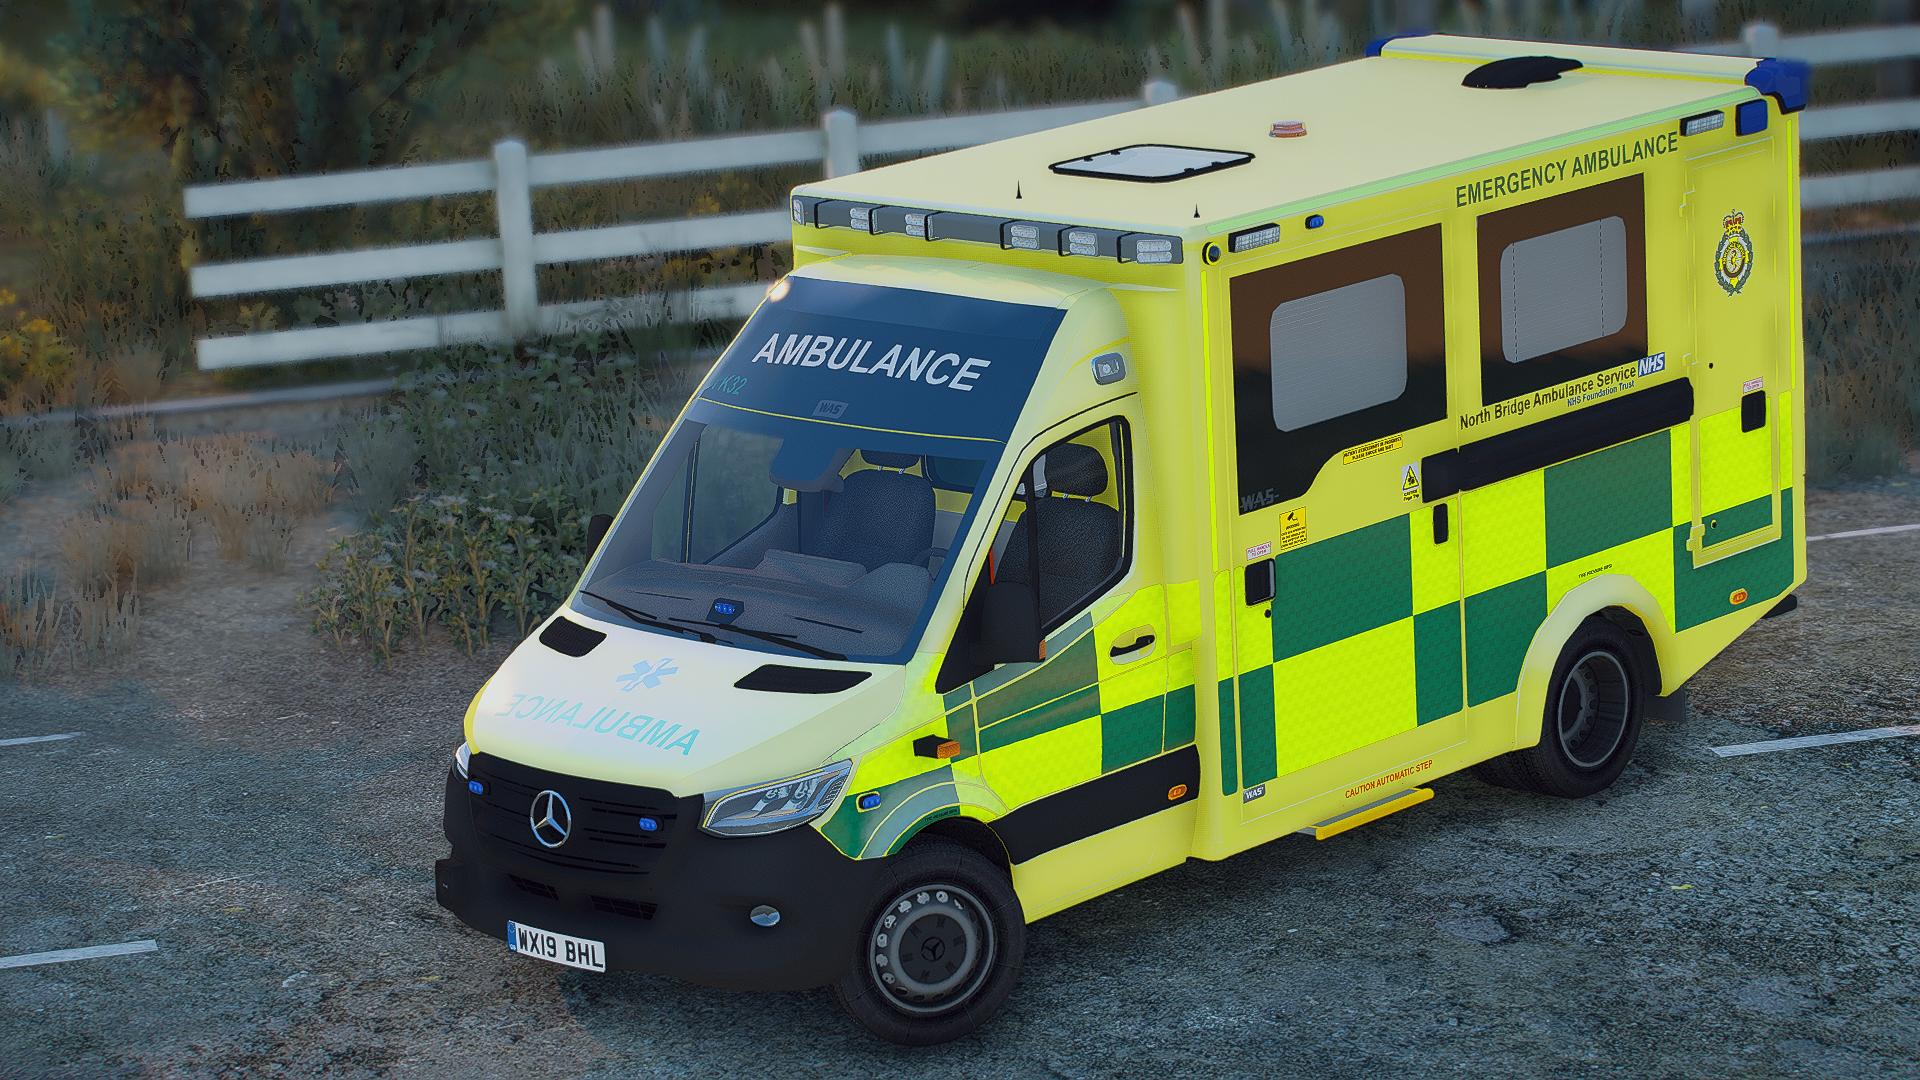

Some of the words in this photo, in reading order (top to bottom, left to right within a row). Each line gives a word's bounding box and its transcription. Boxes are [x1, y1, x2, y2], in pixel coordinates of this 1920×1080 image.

[1456, 159, 1567, 208] EMERGENCY
[1571, 131, 1678, 178] AMBULANCE
[751, 332, 991, 392] AMBULANCE
[1638, 353, 1665, 377] NHS
[818, 400, 842, 416] WAS
[1459, 409, 1491, 430] North
[1494, 400, 1531, 420] Bridge
[1533, 379, 1594, 408] Ambulance
[1596, 366, 1636, 388] Service
[1567, 394, 1582, 407] NHS
[1582, 385, 1618, 403] Foundation
[1618, 380, 1635, 392] Trust
[1345, 782, 1375, 799] CAUTION
[1376, 767, 1415, 788] AUTOMATIC
[1415, 760, 1433, 773] STEP
[518, 927, 557, 958] WX19
[565, 940, 604, 968] BHL
